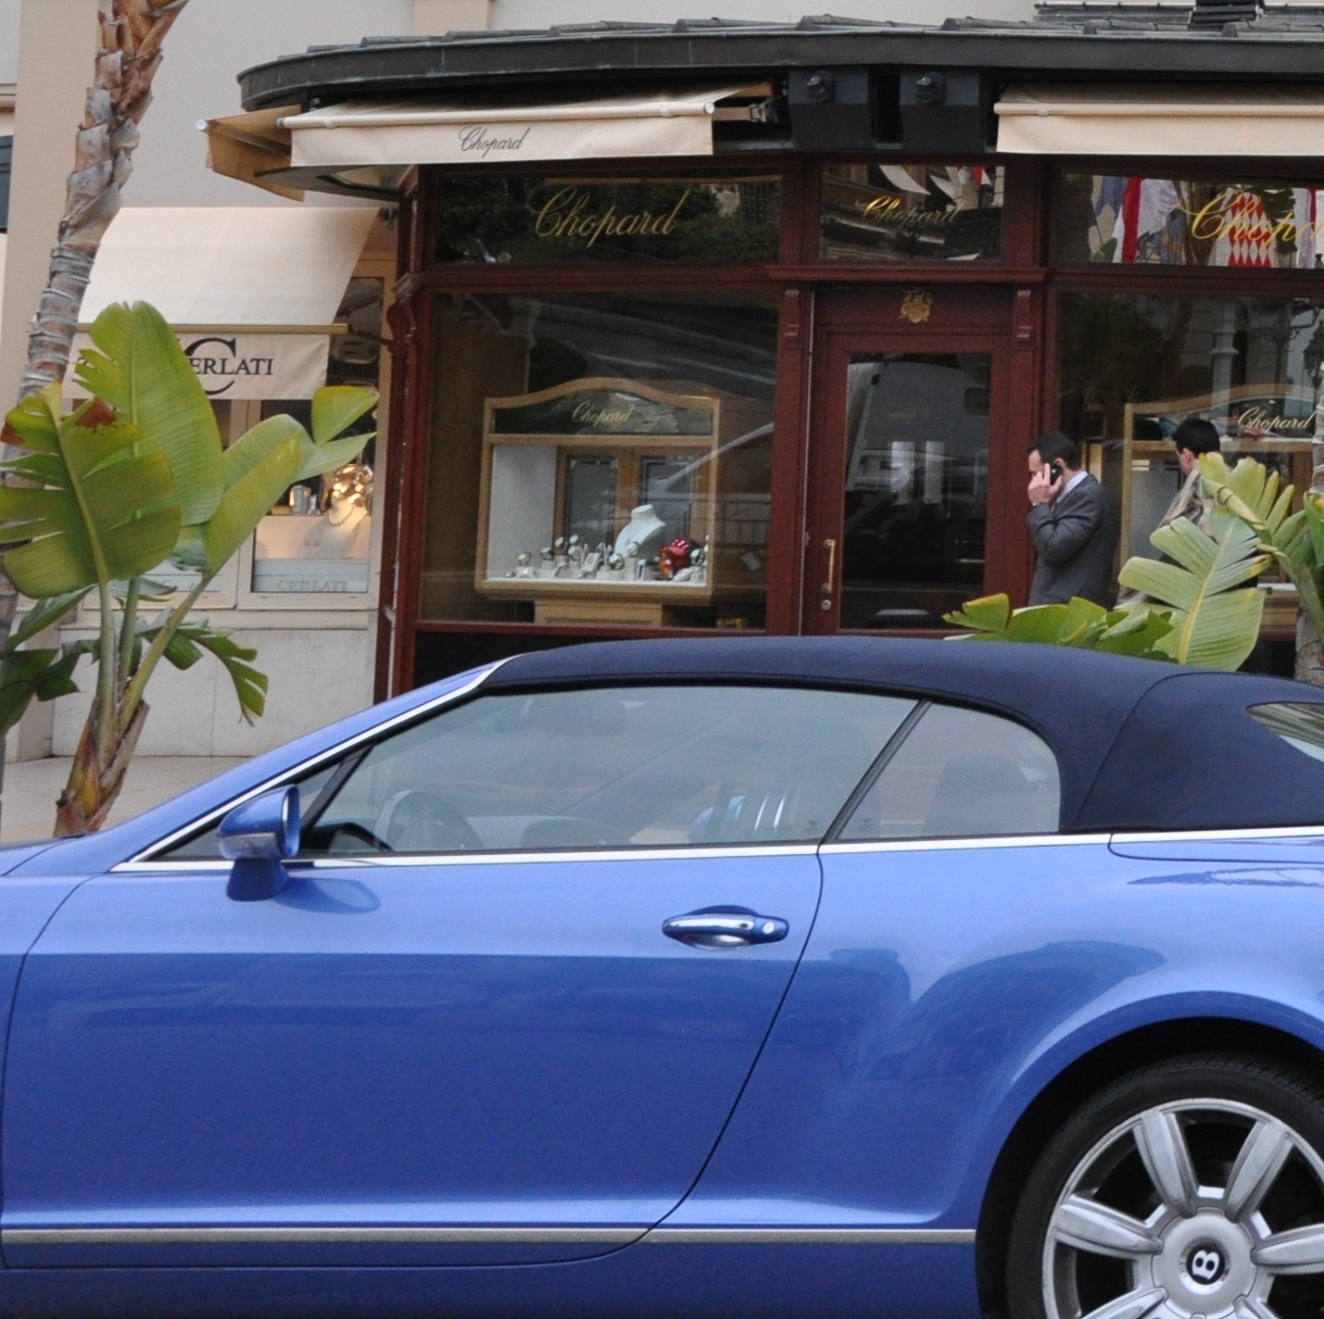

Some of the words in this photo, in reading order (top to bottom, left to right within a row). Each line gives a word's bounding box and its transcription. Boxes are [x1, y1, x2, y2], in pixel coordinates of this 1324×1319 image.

[458, 126, 531, 159] Chopard
[527, 185, 690, 248] Chopard
[571, 399, 636, 427] Chopard
[1233, 406, 1317, 432] Chopard
